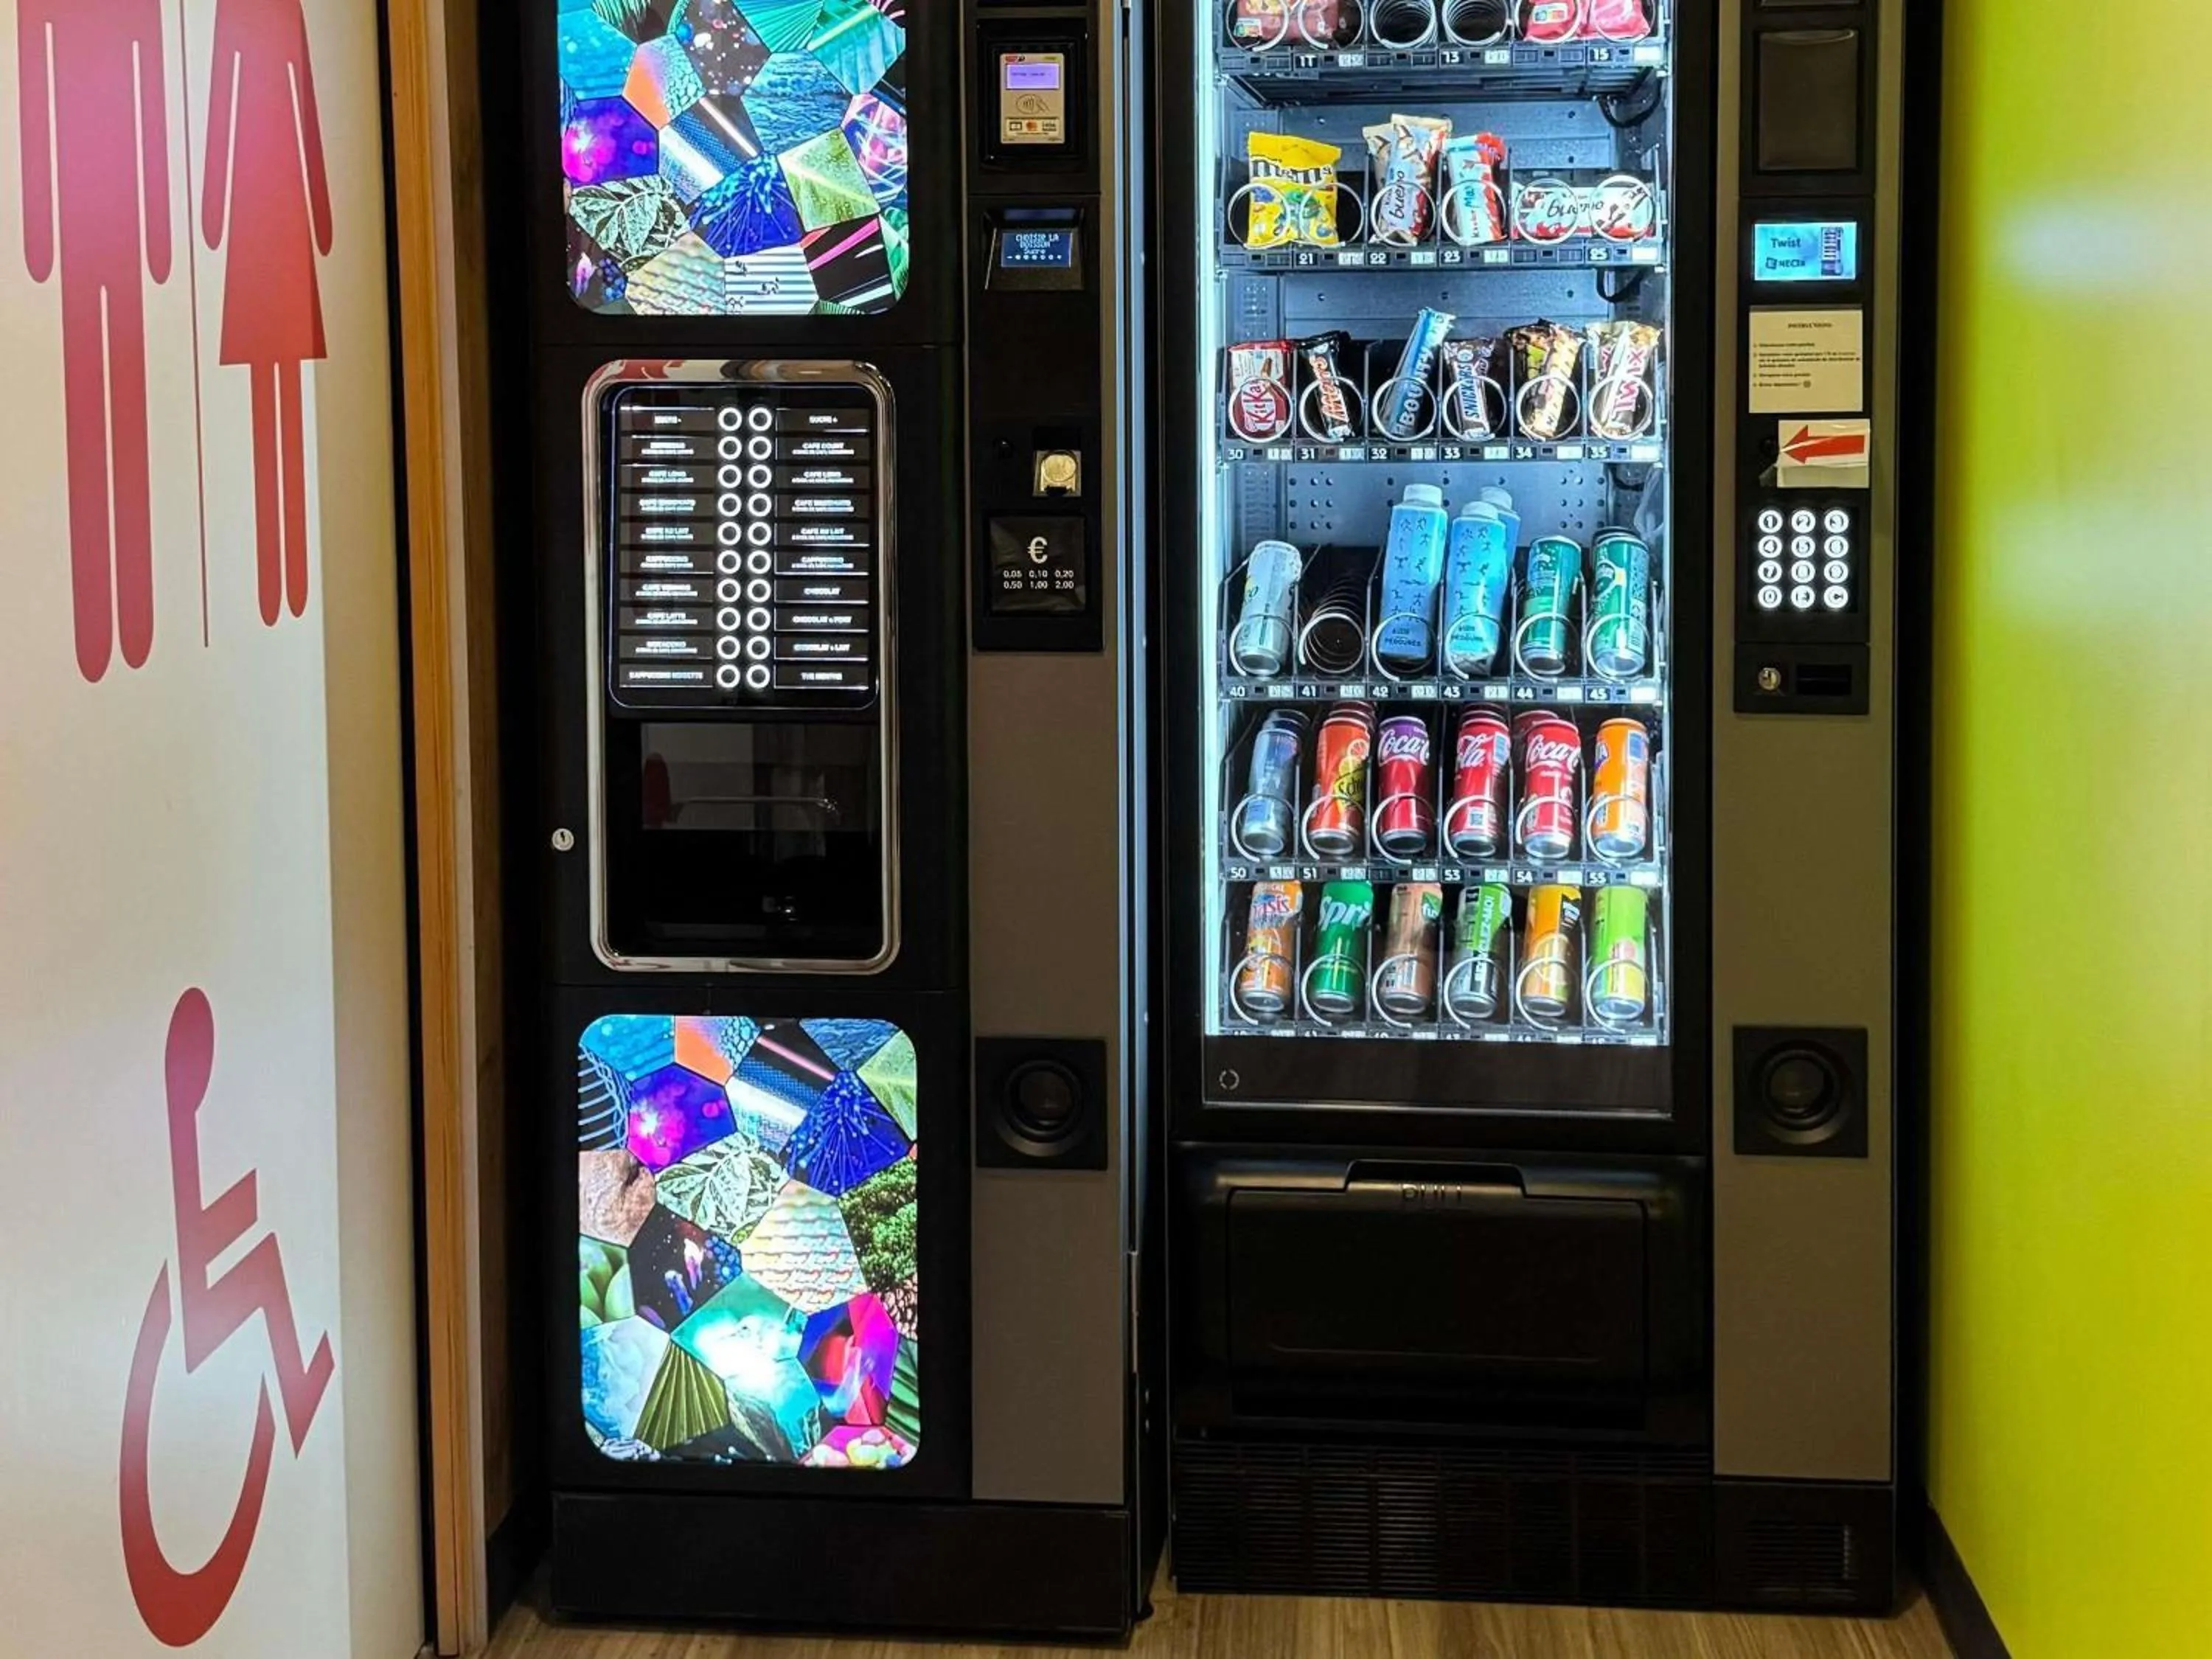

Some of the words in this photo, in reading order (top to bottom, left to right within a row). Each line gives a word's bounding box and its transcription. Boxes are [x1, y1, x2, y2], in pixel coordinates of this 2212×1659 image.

[1593, 49, 1609, 60] 15
[1770, 237, 1801, 248] Twist
[1298, 254, 1313, 265] 21
[1370, 254, 1386, 265] 22
[1444, 251, 1461, 262] 23
[1399, 347, 1435, 426] BOUNTY
[1458, 364, 1479, 418] SNICKERS
[1228, 448, 1244, 459] 30
[1301, 448, 1315, 459] 31
[1371, 448, 1387, 459] 32
[1444, 447, 1461, 459] 33
[1027, 536, 1048, 563] €
[1229, 686, 1245, 698] 40
[1301, 686, 1316, 697] 41
[1372, 686, 1388, 698] 42
[1444, 686, 1461, 698] 43
[1517, 687, 1534, 698] 44
[1590, 687, 1607, 699] 45
[1231, 867, 1246, 878] 50
[1304, 867, 1317, 878] 51
[1444, 870, 1461, 881] 53
[1517, 871, 1534, 883] 54
[1318, 896, 1370, 931] Spri
